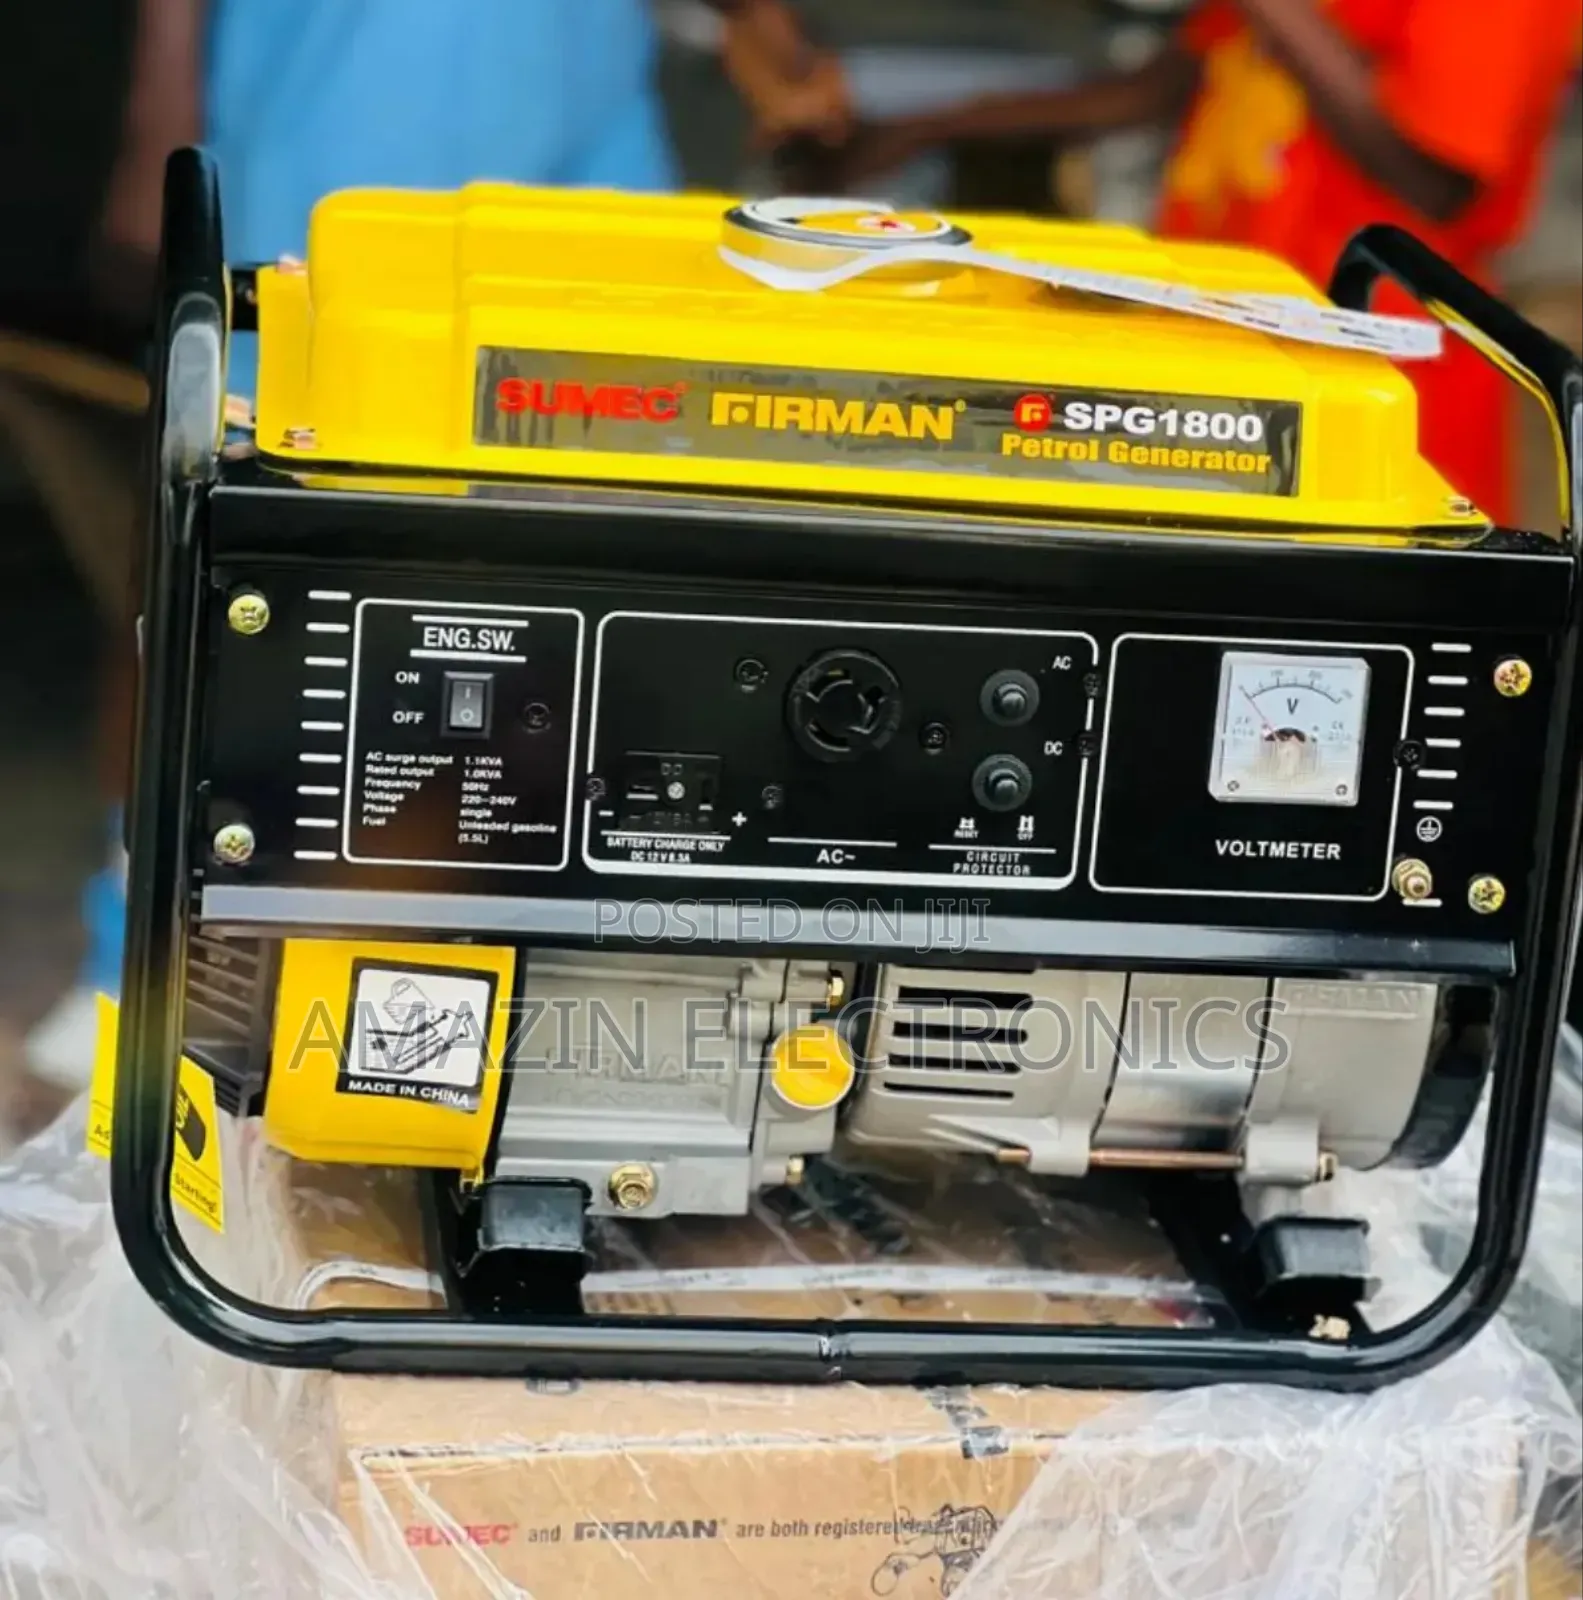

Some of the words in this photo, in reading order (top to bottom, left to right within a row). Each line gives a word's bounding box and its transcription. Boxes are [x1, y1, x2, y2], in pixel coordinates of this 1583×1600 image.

[1063, 401, 1262, 443] SPG1800
[1002, 433, 1099, 462] Petrol
[1108, 440, 1271, 473] Generator
[423, 625, 516, 651] ENG.SW.
[1052, 656, 1072, 670] AC
[395, 671, 420, 684] ON
[1287, 698, 1299, 715] V
[393, 711, 424, 724] OFF
[1044, 741, 1063, 755] DC
[366, 751, 383, 762] AC
[385, 753, 416, 764] surge
[418, 755, 454, 765] output
[365, 764, 398, 775] Rated
[399, 766, 435, 777] output
[365, 776, 422, 790] Frequency
[461, 781, 490, 791] 50Hz
[364, 790, 405, 802] Voltage
[363, 803, 397, 814] Phase
[460, 808, 492, 819] single
[362, 815, 387, 826] Fuel
[458, 820, 510, 831] Unleaded
[511, 823, 557, 834] gasoline
[607, 836, 653, 849] BATTERY
[654, 838, 697, 851] CHARGE
[698, 840, 725, 852] ONLY
[1215, 839, 1341, 860] VOLTMETER
[631, 850, 645, 861] DC
[966, 850, 1020, 863] CIRCUIT
[952, 862, 1031, 875] PROTECTOR
[348, 1079, 395, 1095] MADE
[400, 1085, 416, 1097] IN
[420, 1087, 470, 1108] CHINA
[527, 1523, 561, 1544] and
[735, 1522, 765, 1538] are
[770, 1518, 808, 1538] both
